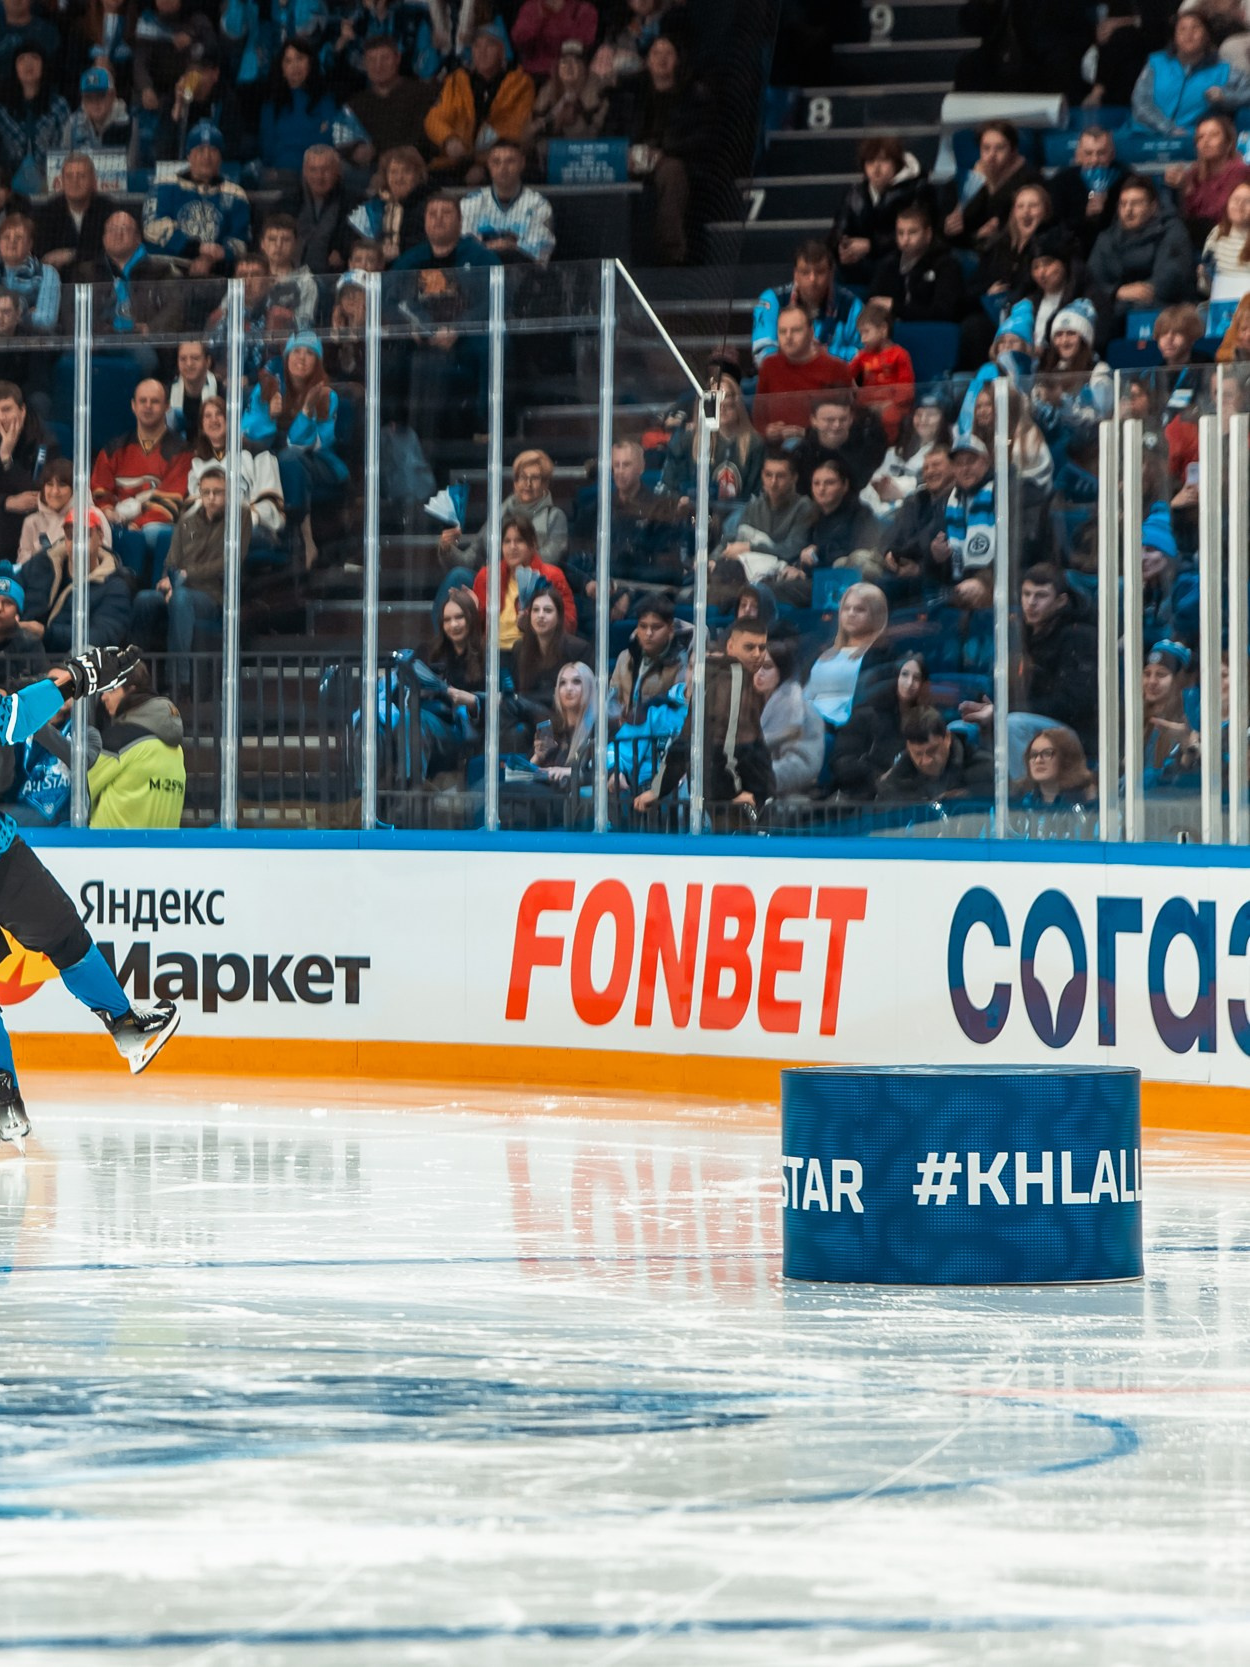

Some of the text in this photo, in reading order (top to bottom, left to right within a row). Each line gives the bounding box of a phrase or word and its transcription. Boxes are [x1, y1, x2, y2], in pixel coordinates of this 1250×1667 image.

[869, 3, 894, 42] 9
[808, 96, 832, 131] 8
[743, 189, 765, 220] 7
[76, 654, 97, 695] CCM
[80, 880, 225, 932] Яндекс
[95, 941, 371, 1013] Маркет
[505, 879, 868, 1037] FONBET
[913, 1147, 1142, 1206] #KHLALL
